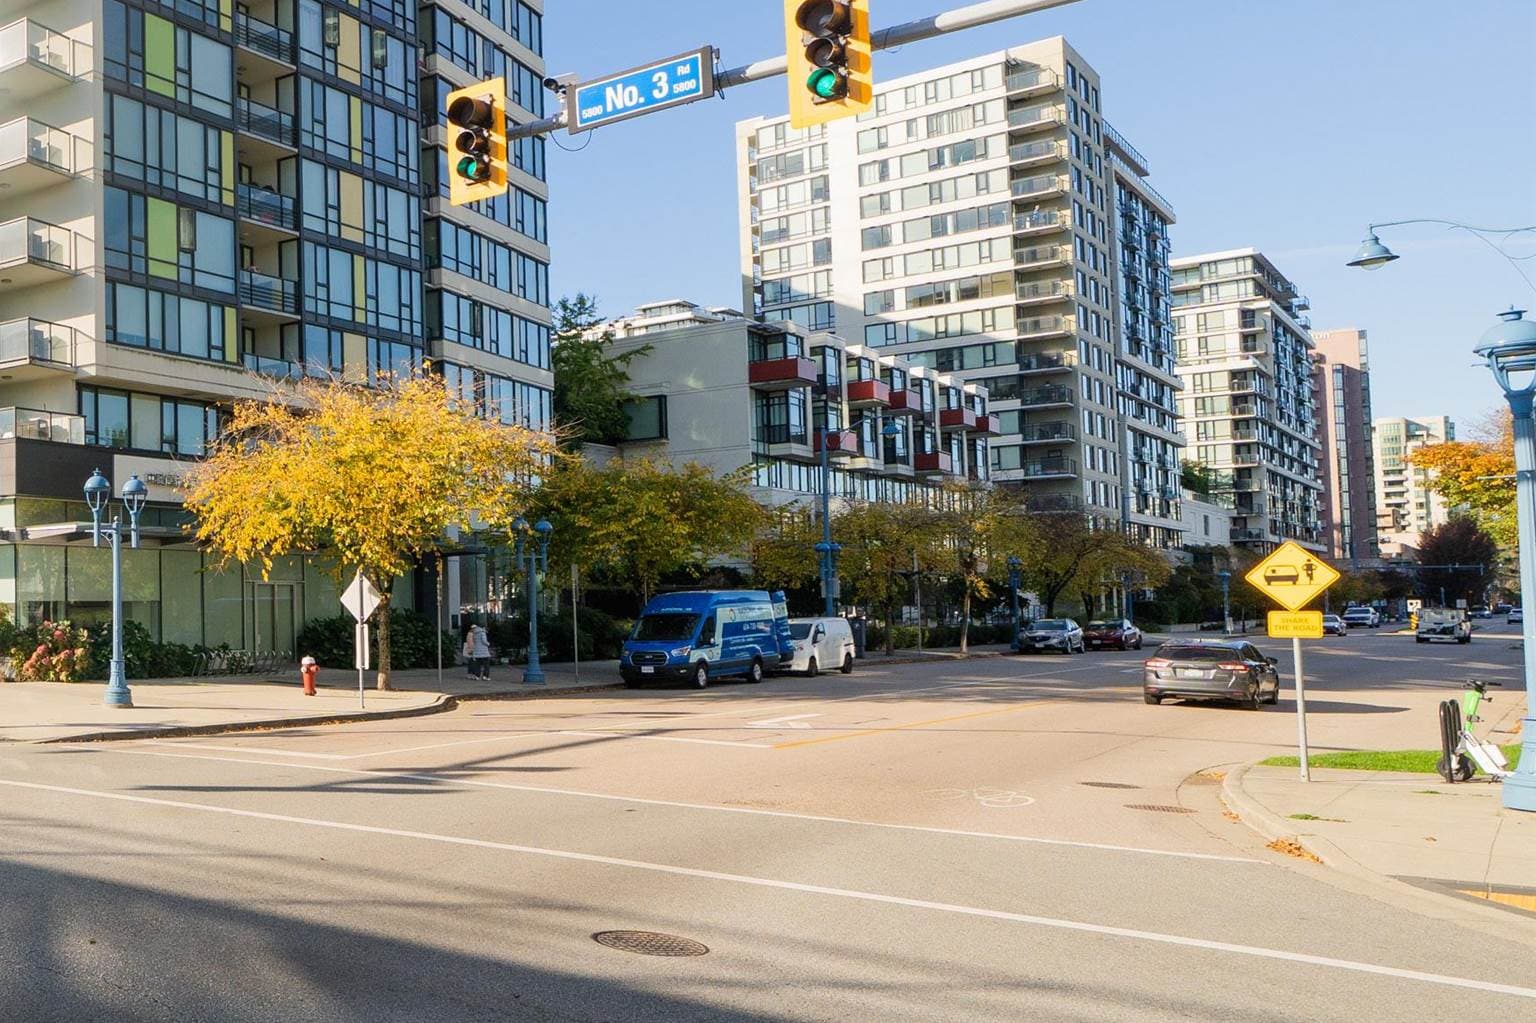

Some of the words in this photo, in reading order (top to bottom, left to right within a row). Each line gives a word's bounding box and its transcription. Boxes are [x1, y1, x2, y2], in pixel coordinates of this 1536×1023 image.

[605, 83, 645, 112] No.
[651, 71, 669, 99] 3
[676, 64, 690, 76] Rd
[672, 79, 696, 94] 5800
